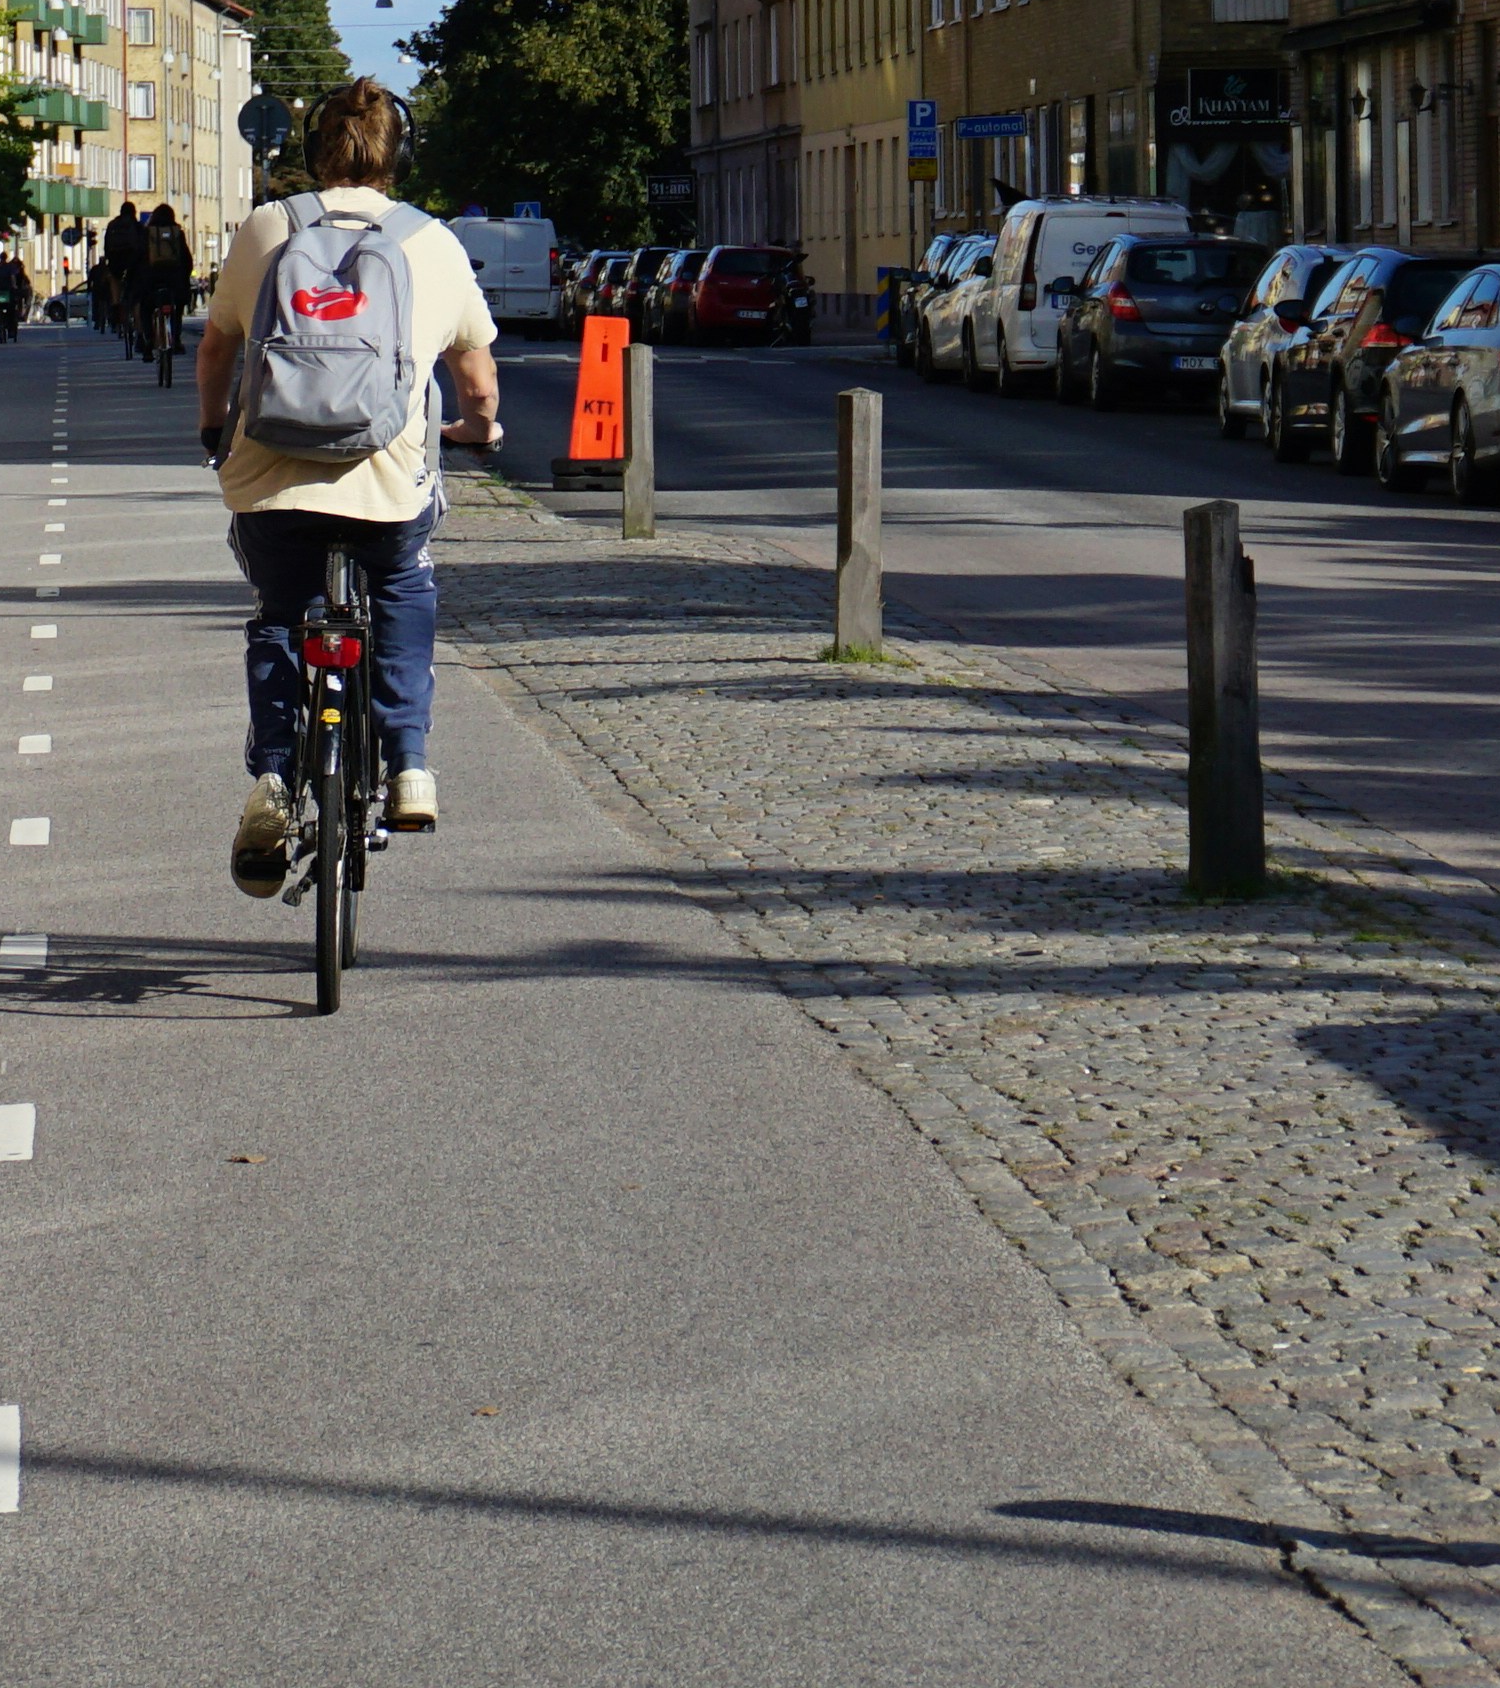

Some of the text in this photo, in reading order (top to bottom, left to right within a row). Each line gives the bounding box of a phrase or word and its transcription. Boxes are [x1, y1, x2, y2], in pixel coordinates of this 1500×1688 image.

[915, 103, 932, 126] P
[1199, 97, 1270, 116] KHAYYAM
[959, 121, 1023, 134] P-automat
[584, 400, 615, 416] KTT
